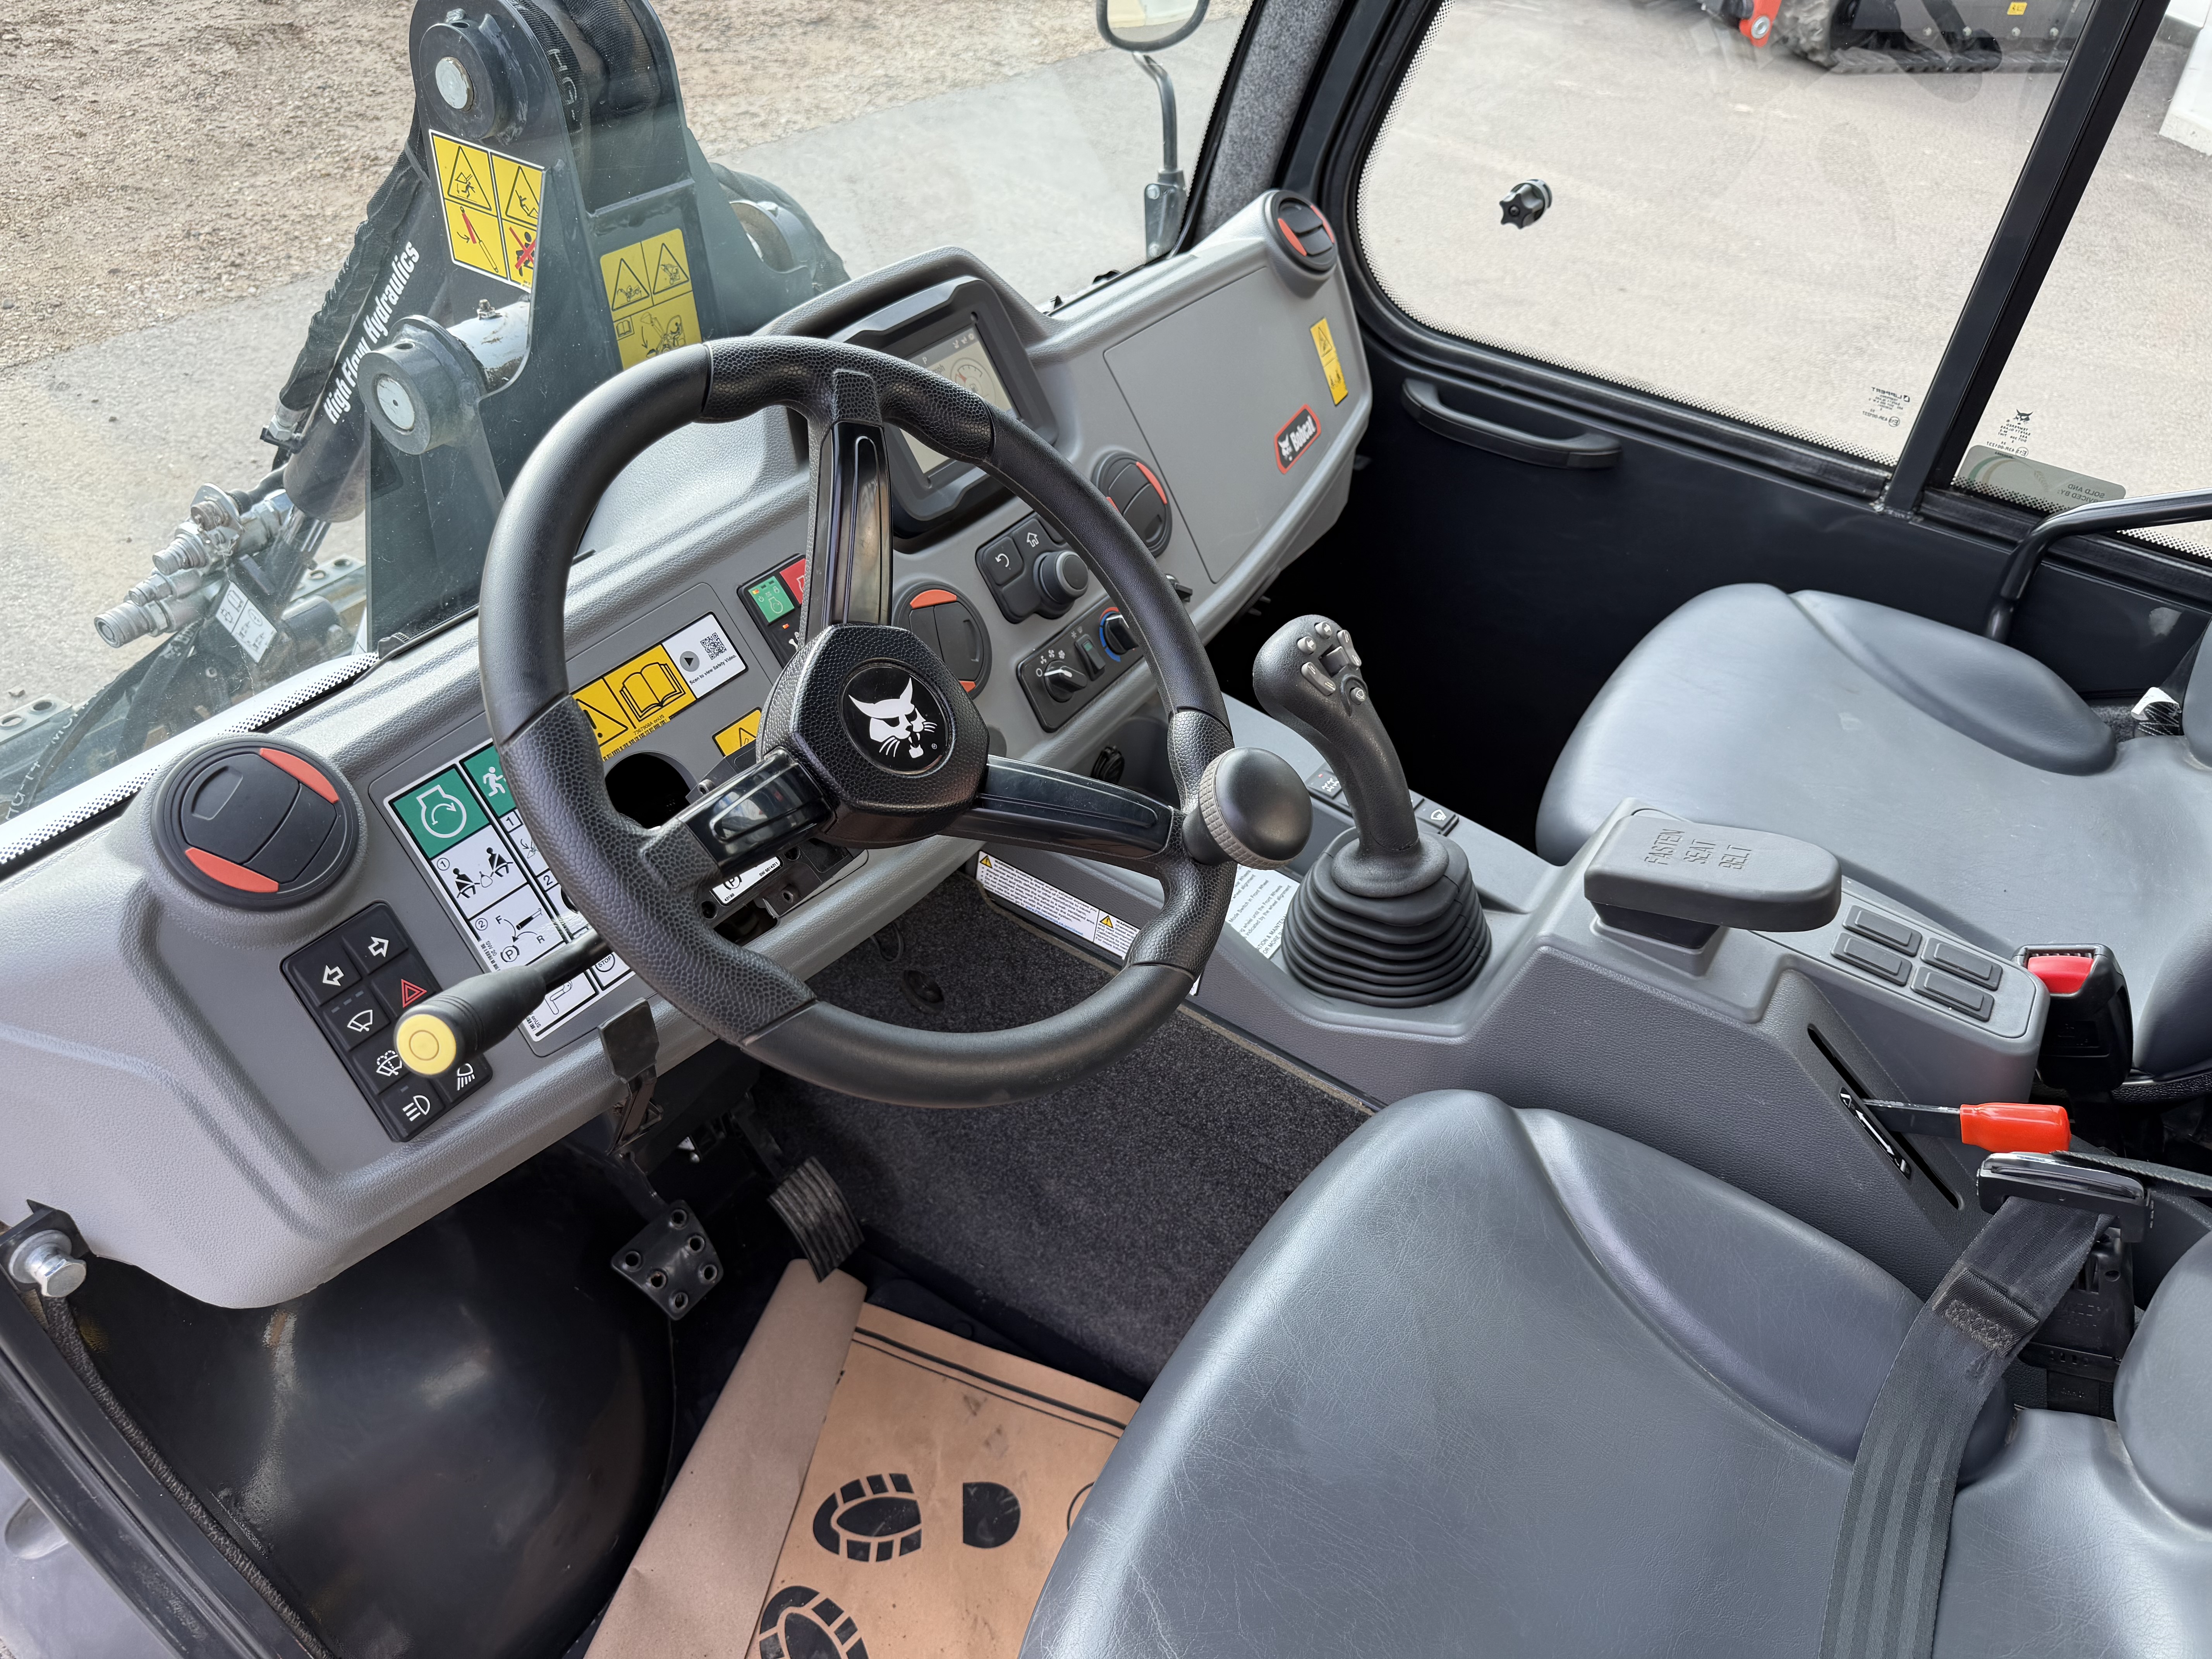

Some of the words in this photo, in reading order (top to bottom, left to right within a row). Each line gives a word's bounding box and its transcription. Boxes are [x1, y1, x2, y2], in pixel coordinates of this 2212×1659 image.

[324, 377, 352, 424] High
[342, 336, 371, 387] Flow
[363, 241, 419, 343] Hydraulics
[1290, 415, 1316, 452] Bobcat
[713, 661, 725, 670] Safety
[506, 816, 514, 826] 1
[1644, 829, 1685, 865] FASTEN
[1683, 839, 1716, 864] SEAT
[1718, 845, 1752, 869] BELT
[543, 875, 553, 886] 2
[1056, 895, 1074, 905] California
[1228, 913, 1239, 922] Mode
[1237, 902, 1249, 913] Switch
[1250, 889, 1260, 898] Front
[1258, 879, 1269, 890] Wheel
[1268, 900, 1278, 910] wheel
[1243, 918, 1253, 928] wheel
[1262, 896, 1273, 905] Front
[1270, 885, 1283, 896] Wheels
[495, 915, 502, 924] F
[486, 941, 493, 949] SW
[536, 935, 545, 944] R
[1267, 935, 1280, 948] MORE
[598, 956, 612, 967] STOP
[531, 1016, 541, 1028] enUS
